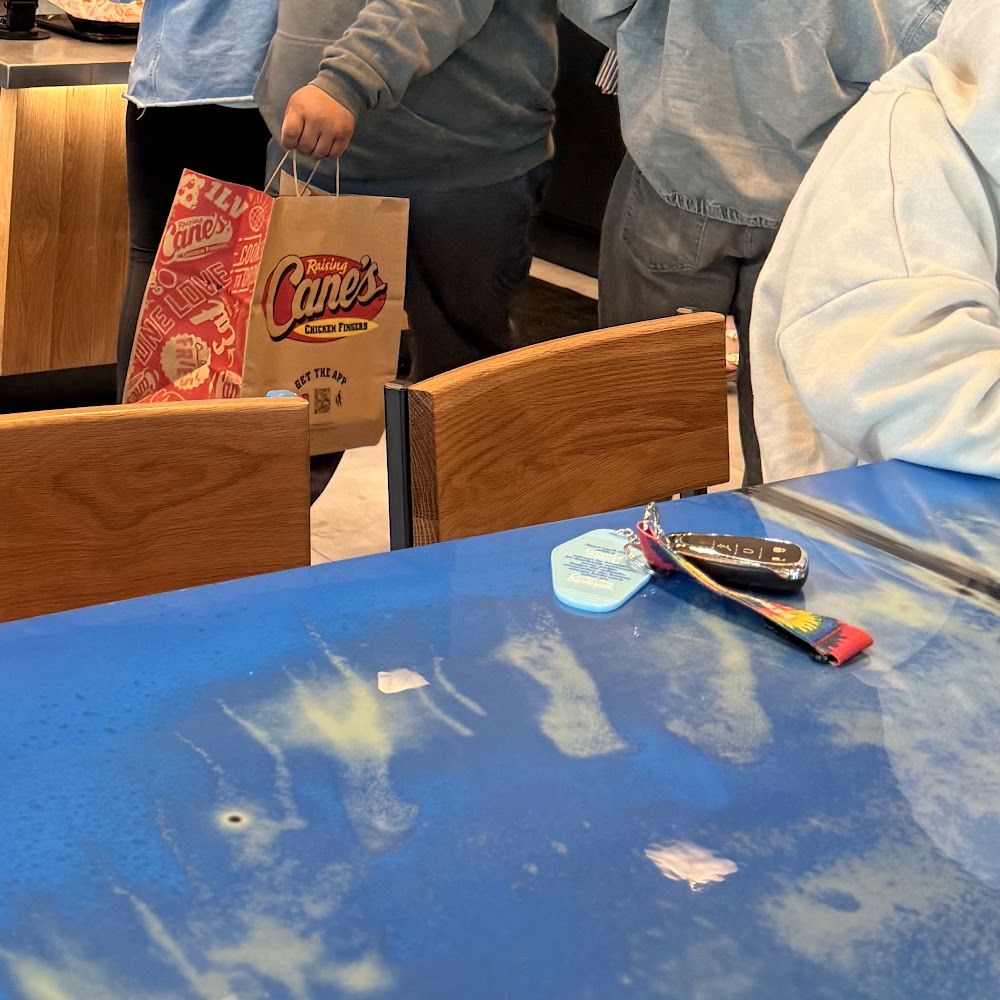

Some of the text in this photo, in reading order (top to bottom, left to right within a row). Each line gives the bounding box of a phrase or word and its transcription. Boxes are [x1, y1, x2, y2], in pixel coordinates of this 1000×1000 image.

[204, 180, 250, 220] 1LV
[307, 258, 348, 276] Raising
[264, 254, 388, 342] Cane's
[294, 368, 348, 390] GET THE APP
